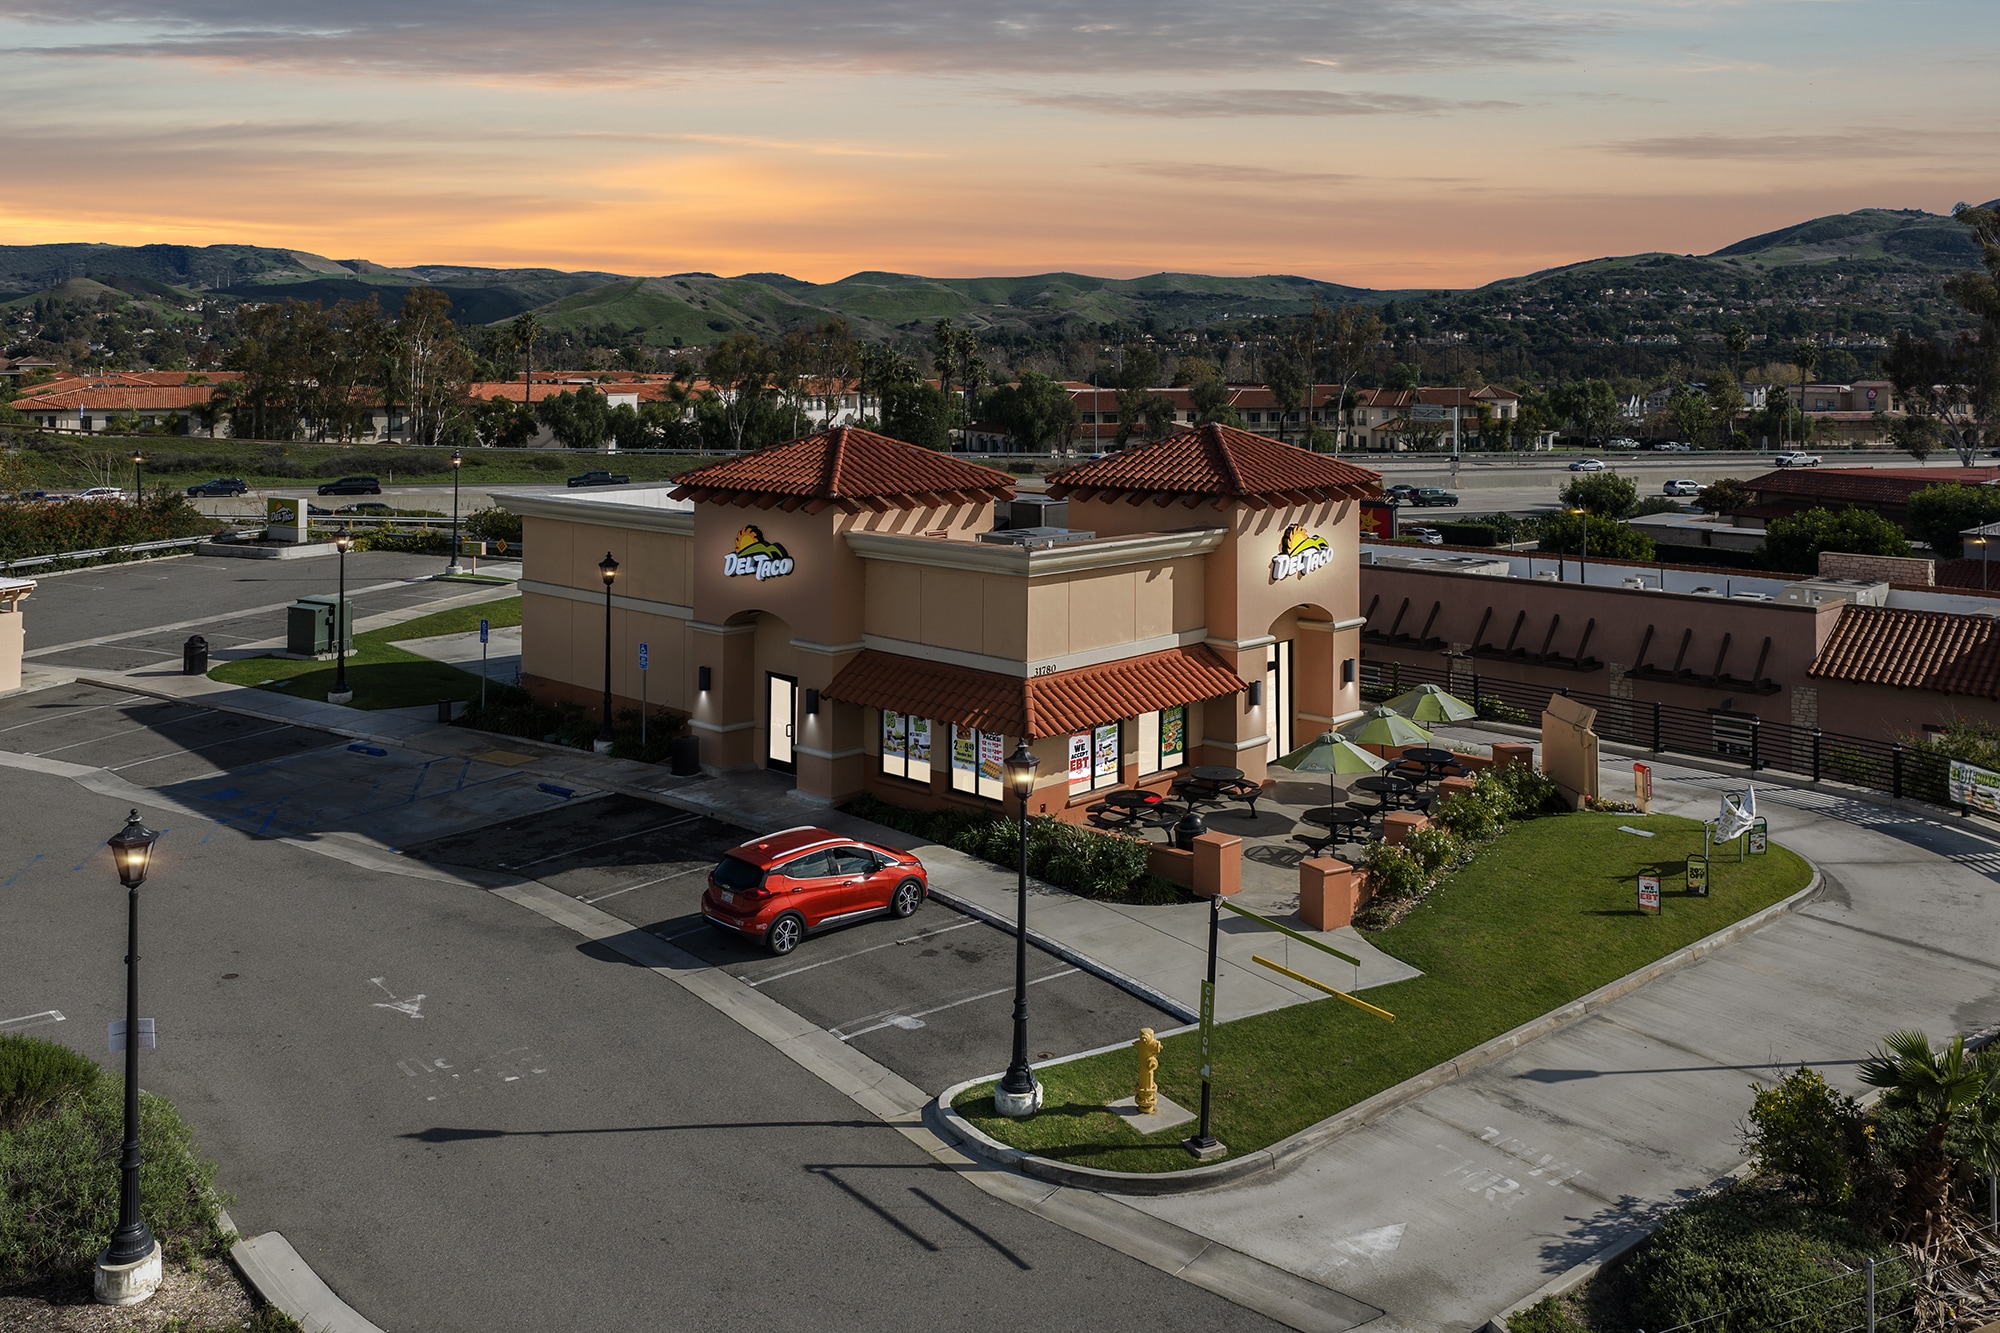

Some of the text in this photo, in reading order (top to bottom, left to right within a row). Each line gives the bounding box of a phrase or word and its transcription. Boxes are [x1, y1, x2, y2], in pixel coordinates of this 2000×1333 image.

[271, 511, 295, 522] DEL TACO
[724, 553, 793, 581] DEL TACO
[1273, 547, 1334, 580] DEL TACO
[1034, 664, 1056, 677] 31780
[1074, 743, 1085, 752] WE
[1071, 750, 1088, 760] ACCEPT
[1070, 756, 1089, 772] EBT
[1960, 767, 1976, 785] BIG
[1640, 893, 1658, 901] EBT
[1202, 986, 1211, 1056] CAUTION
